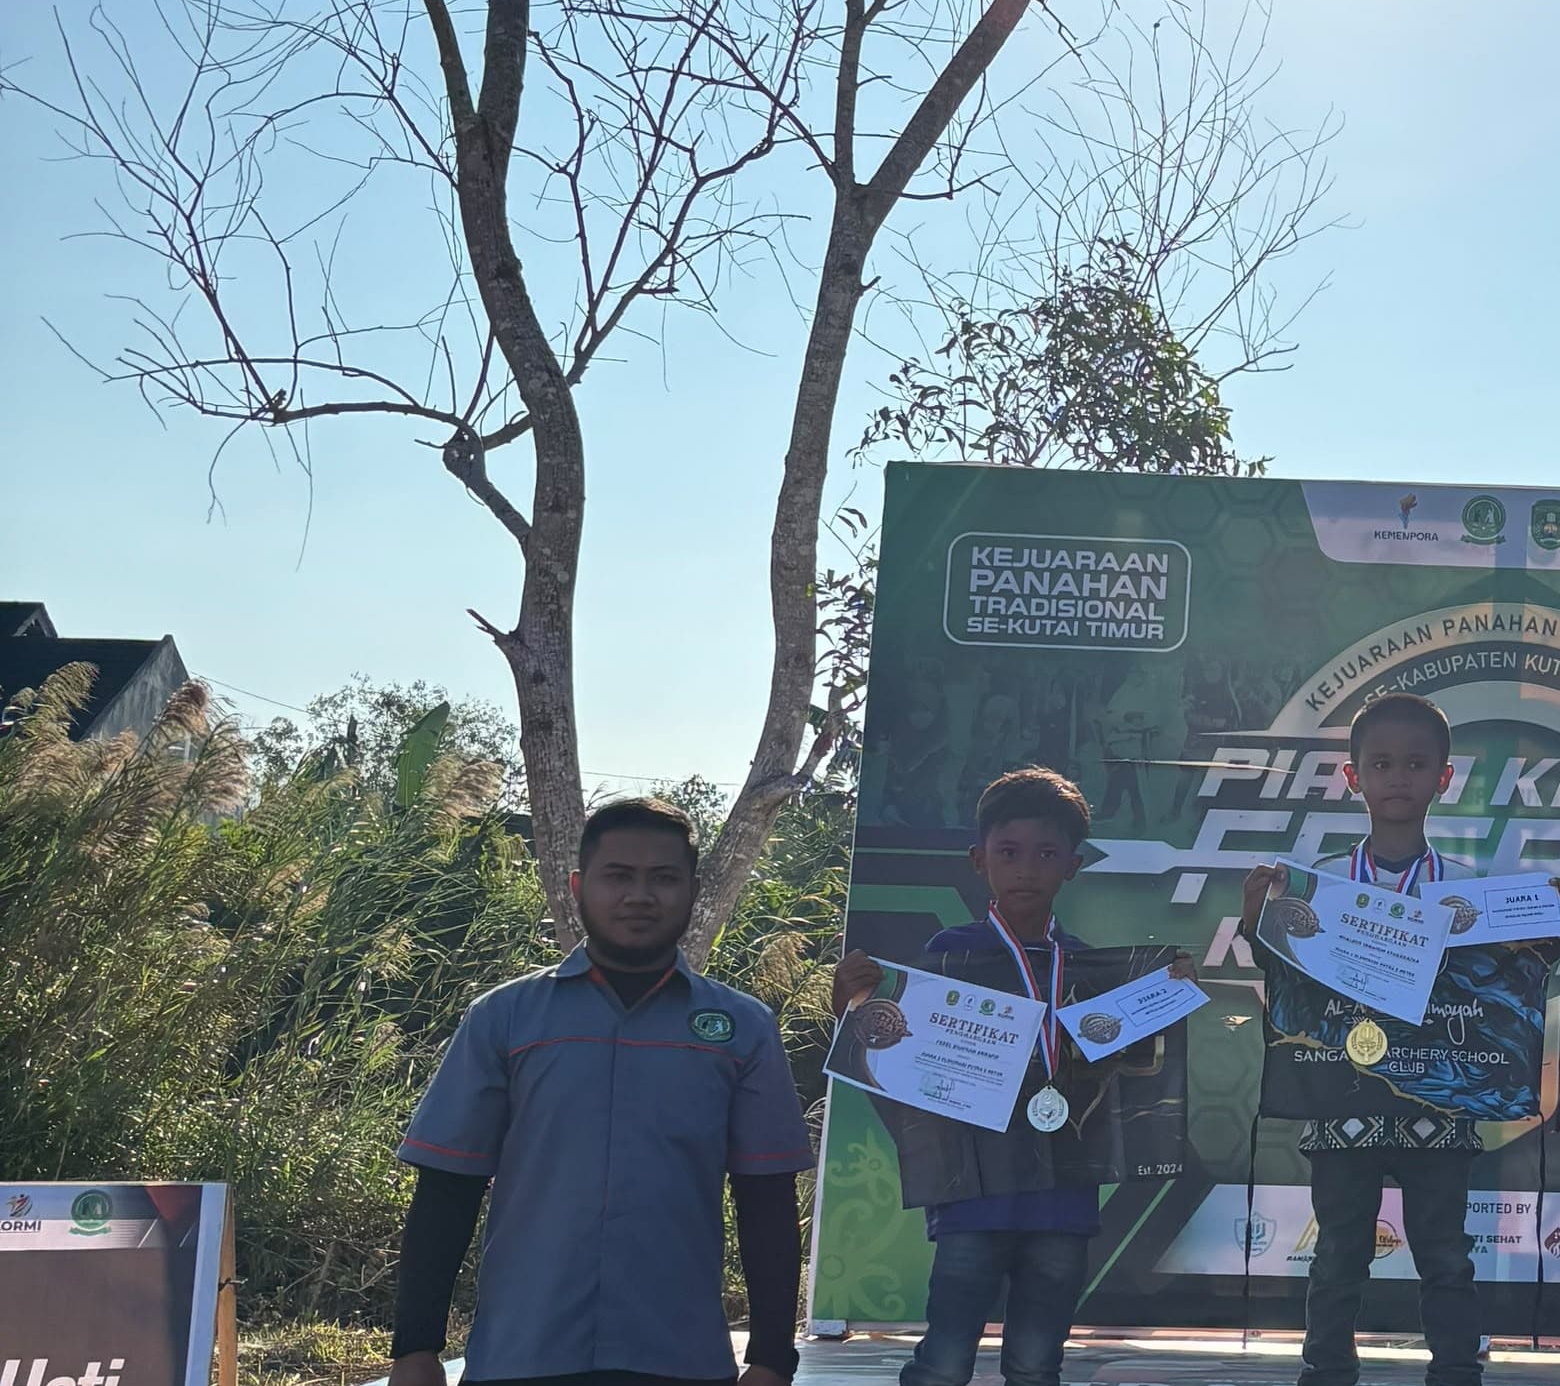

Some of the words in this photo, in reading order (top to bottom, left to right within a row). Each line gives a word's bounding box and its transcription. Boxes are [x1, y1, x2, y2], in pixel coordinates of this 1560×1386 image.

[1373, 529, 1439, 542] KEMENPORA
[970, 546, 1168, 575] KEJUARAAN
[968, 568, 1168, 600] PANAHAN
[968, 595, 1165, 622] TRADISIONAL
[966, 616, 1079, 637] SE-KUTAI
[1085, 620, 1164, 640] TIMUR
[1305, 623, 1435, 712] KEJUARAAN
[1442, 613, 1558, 637] PANAHAN
[1340, 913, 1429, 948] SERTIFIKAT
[928, 1012, 1020, 1045] SERTIFIKAT
[1388, 1061, 1425, 1074] CLUB
[1451, 1050, 1510, 1064] SCHOOL
[1516, 1203, 1531, 1214] BY
[0, 1220, 42, 1231] ORMI
[1486, 1235, 1523, 1244] SEHAT
